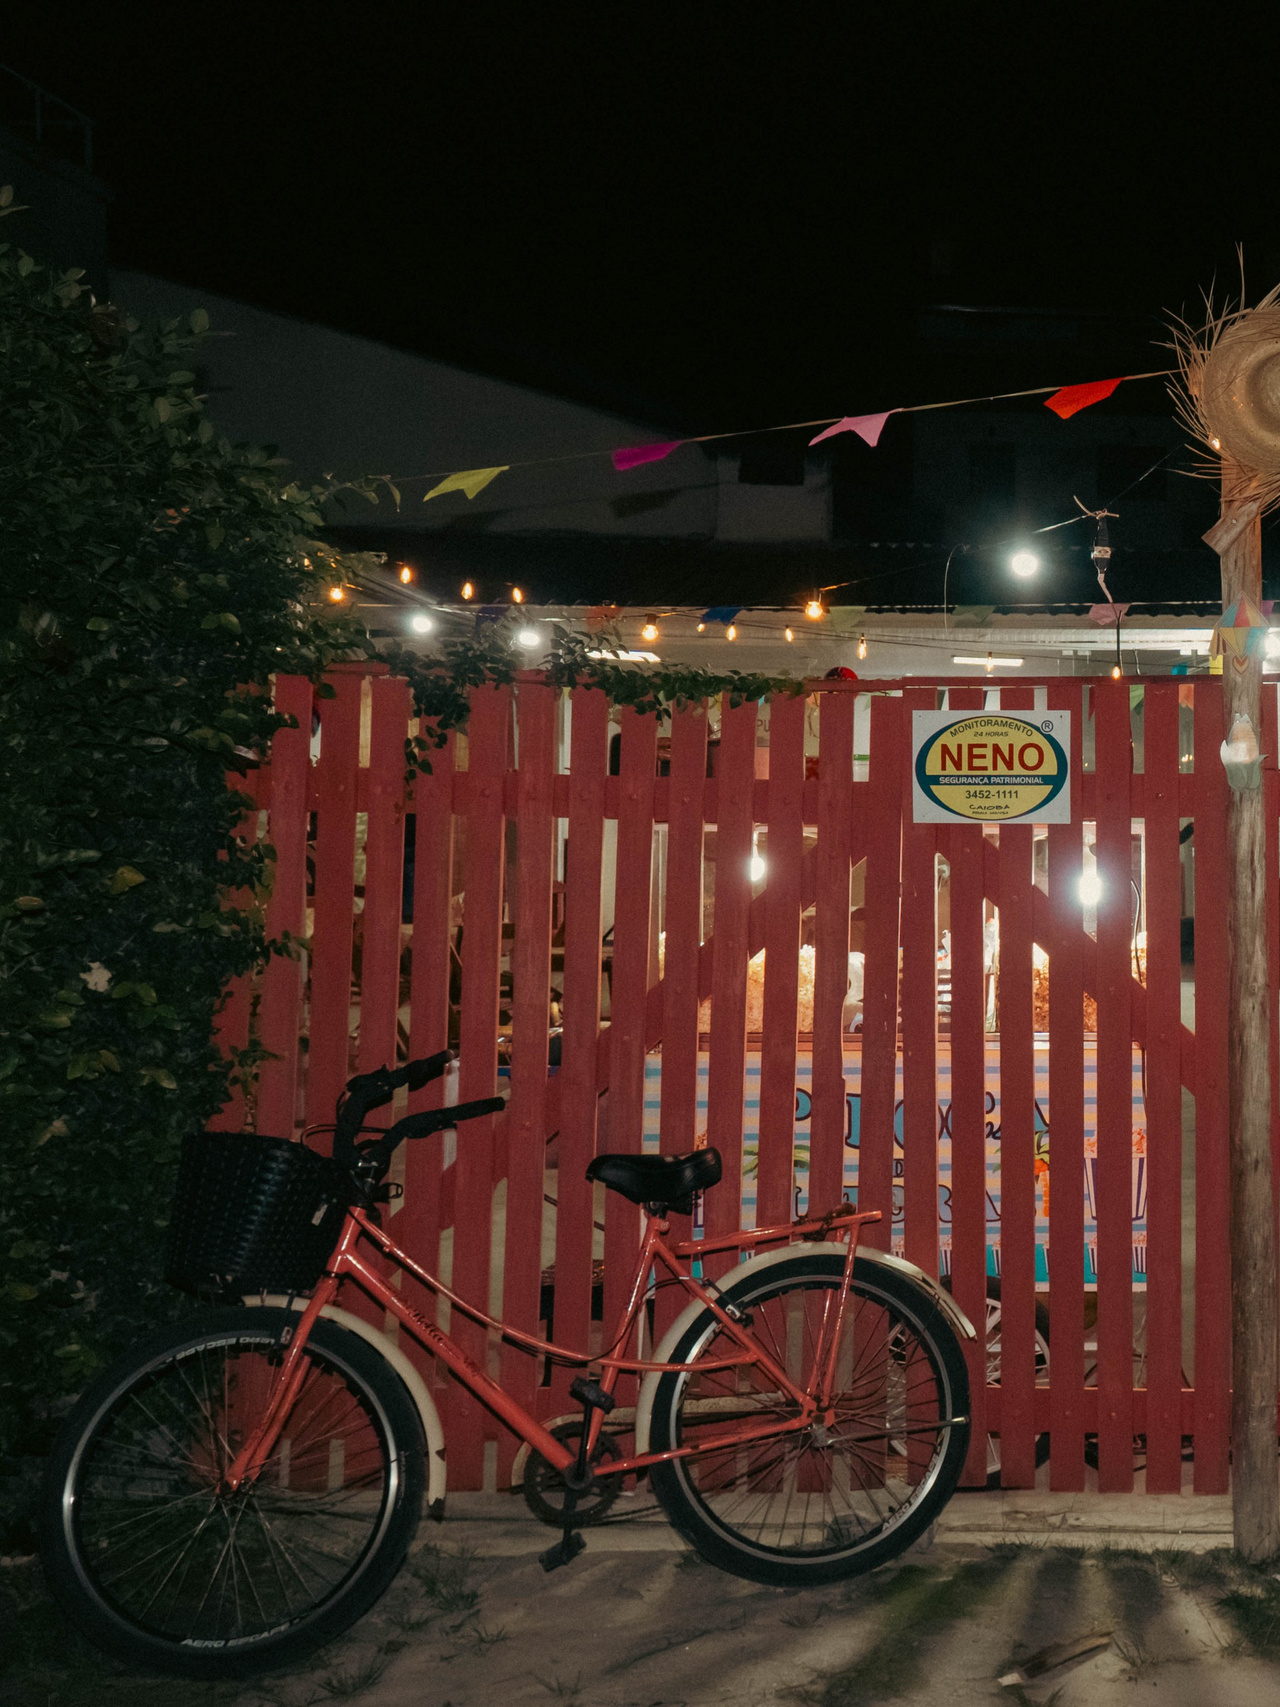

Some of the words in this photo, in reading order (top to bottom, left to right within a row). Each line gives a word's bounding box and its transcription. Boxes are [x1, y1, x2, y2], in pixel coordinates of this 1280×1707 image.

[950, 719, 1033, 738] MONITORAMENTO
[940, 743, 1045, 771] NENO
[939, 776, 989, 785] SEGURANÇA
[991, 776, 1044, 784] PATRIMONIAL
[965, 790, 1019, 799] 3452-1111
